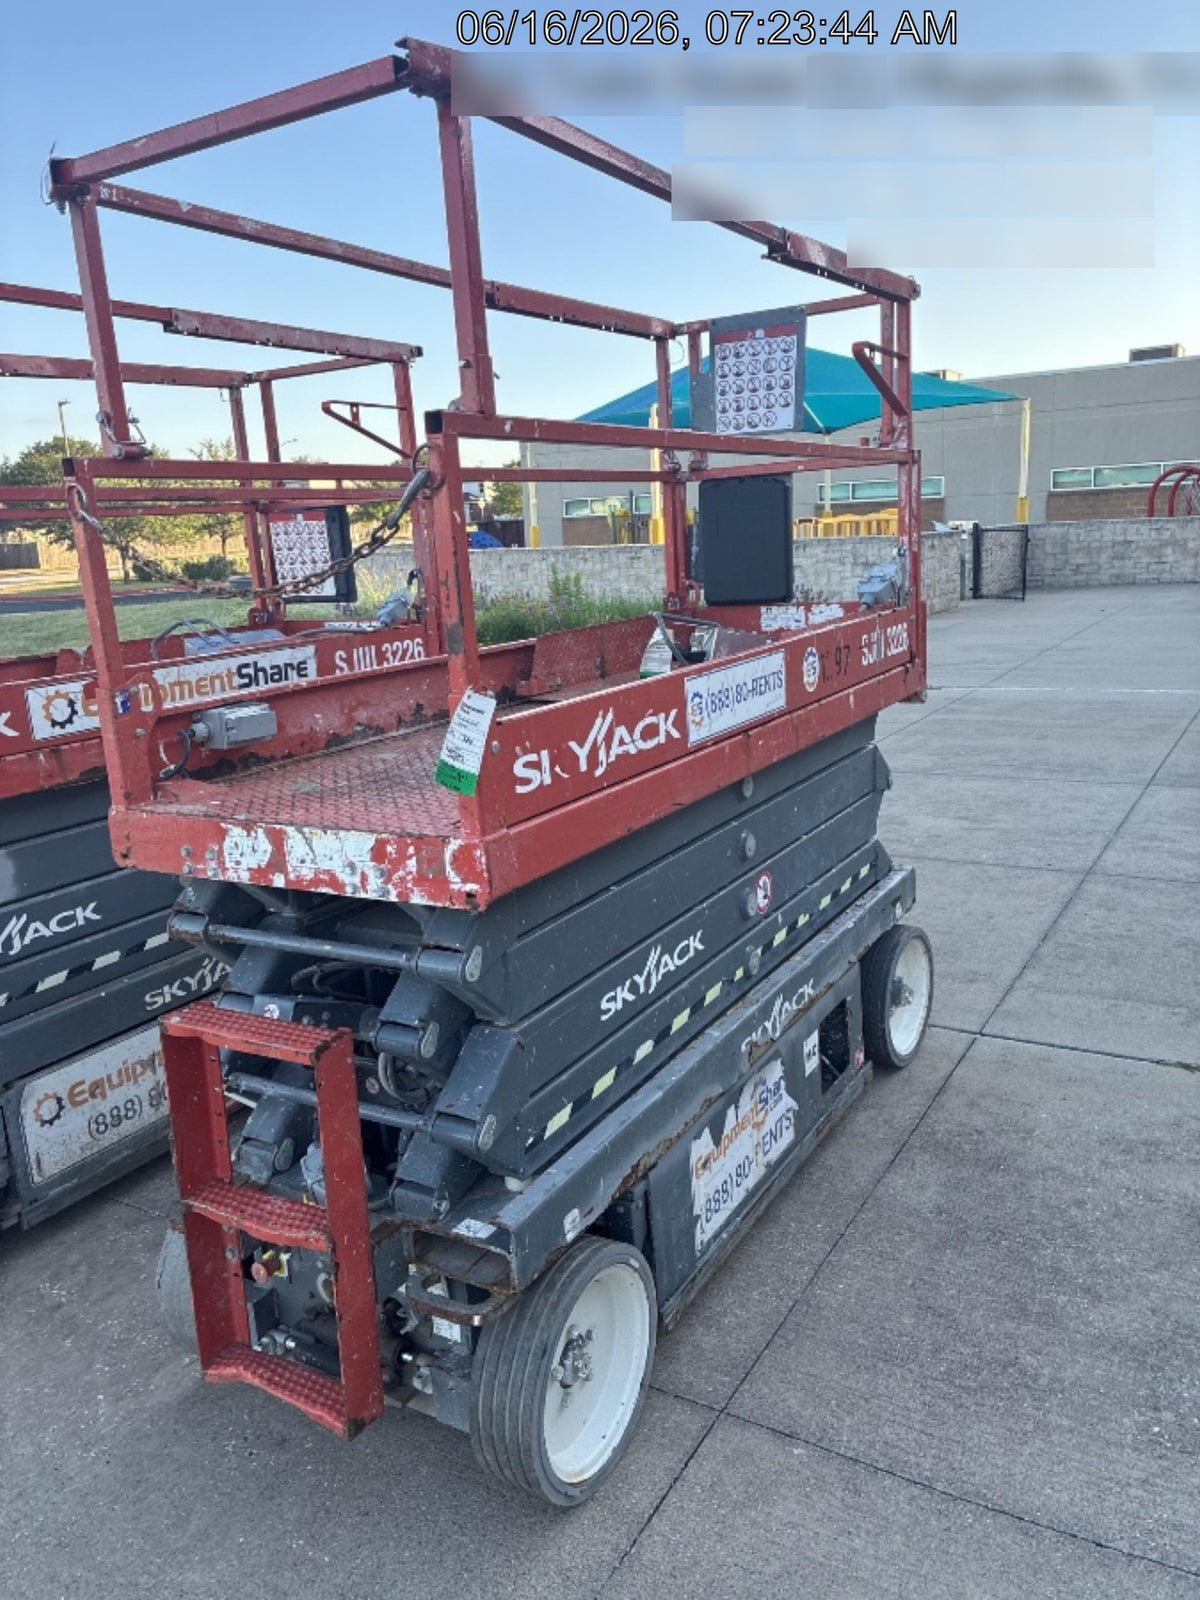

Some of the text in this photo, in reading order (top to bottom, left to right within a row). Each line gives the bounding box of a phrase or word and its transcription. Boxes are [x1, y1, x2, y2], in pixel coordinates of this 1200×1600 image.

[382, 637, 425, 667] 3226
[887, 622, 909, 656] 3226
[600, 929, 705, 1022] SKYJACK
[66, 1050, 165, 1109] Equip
[88, 1094, 143, 1141] (888)
